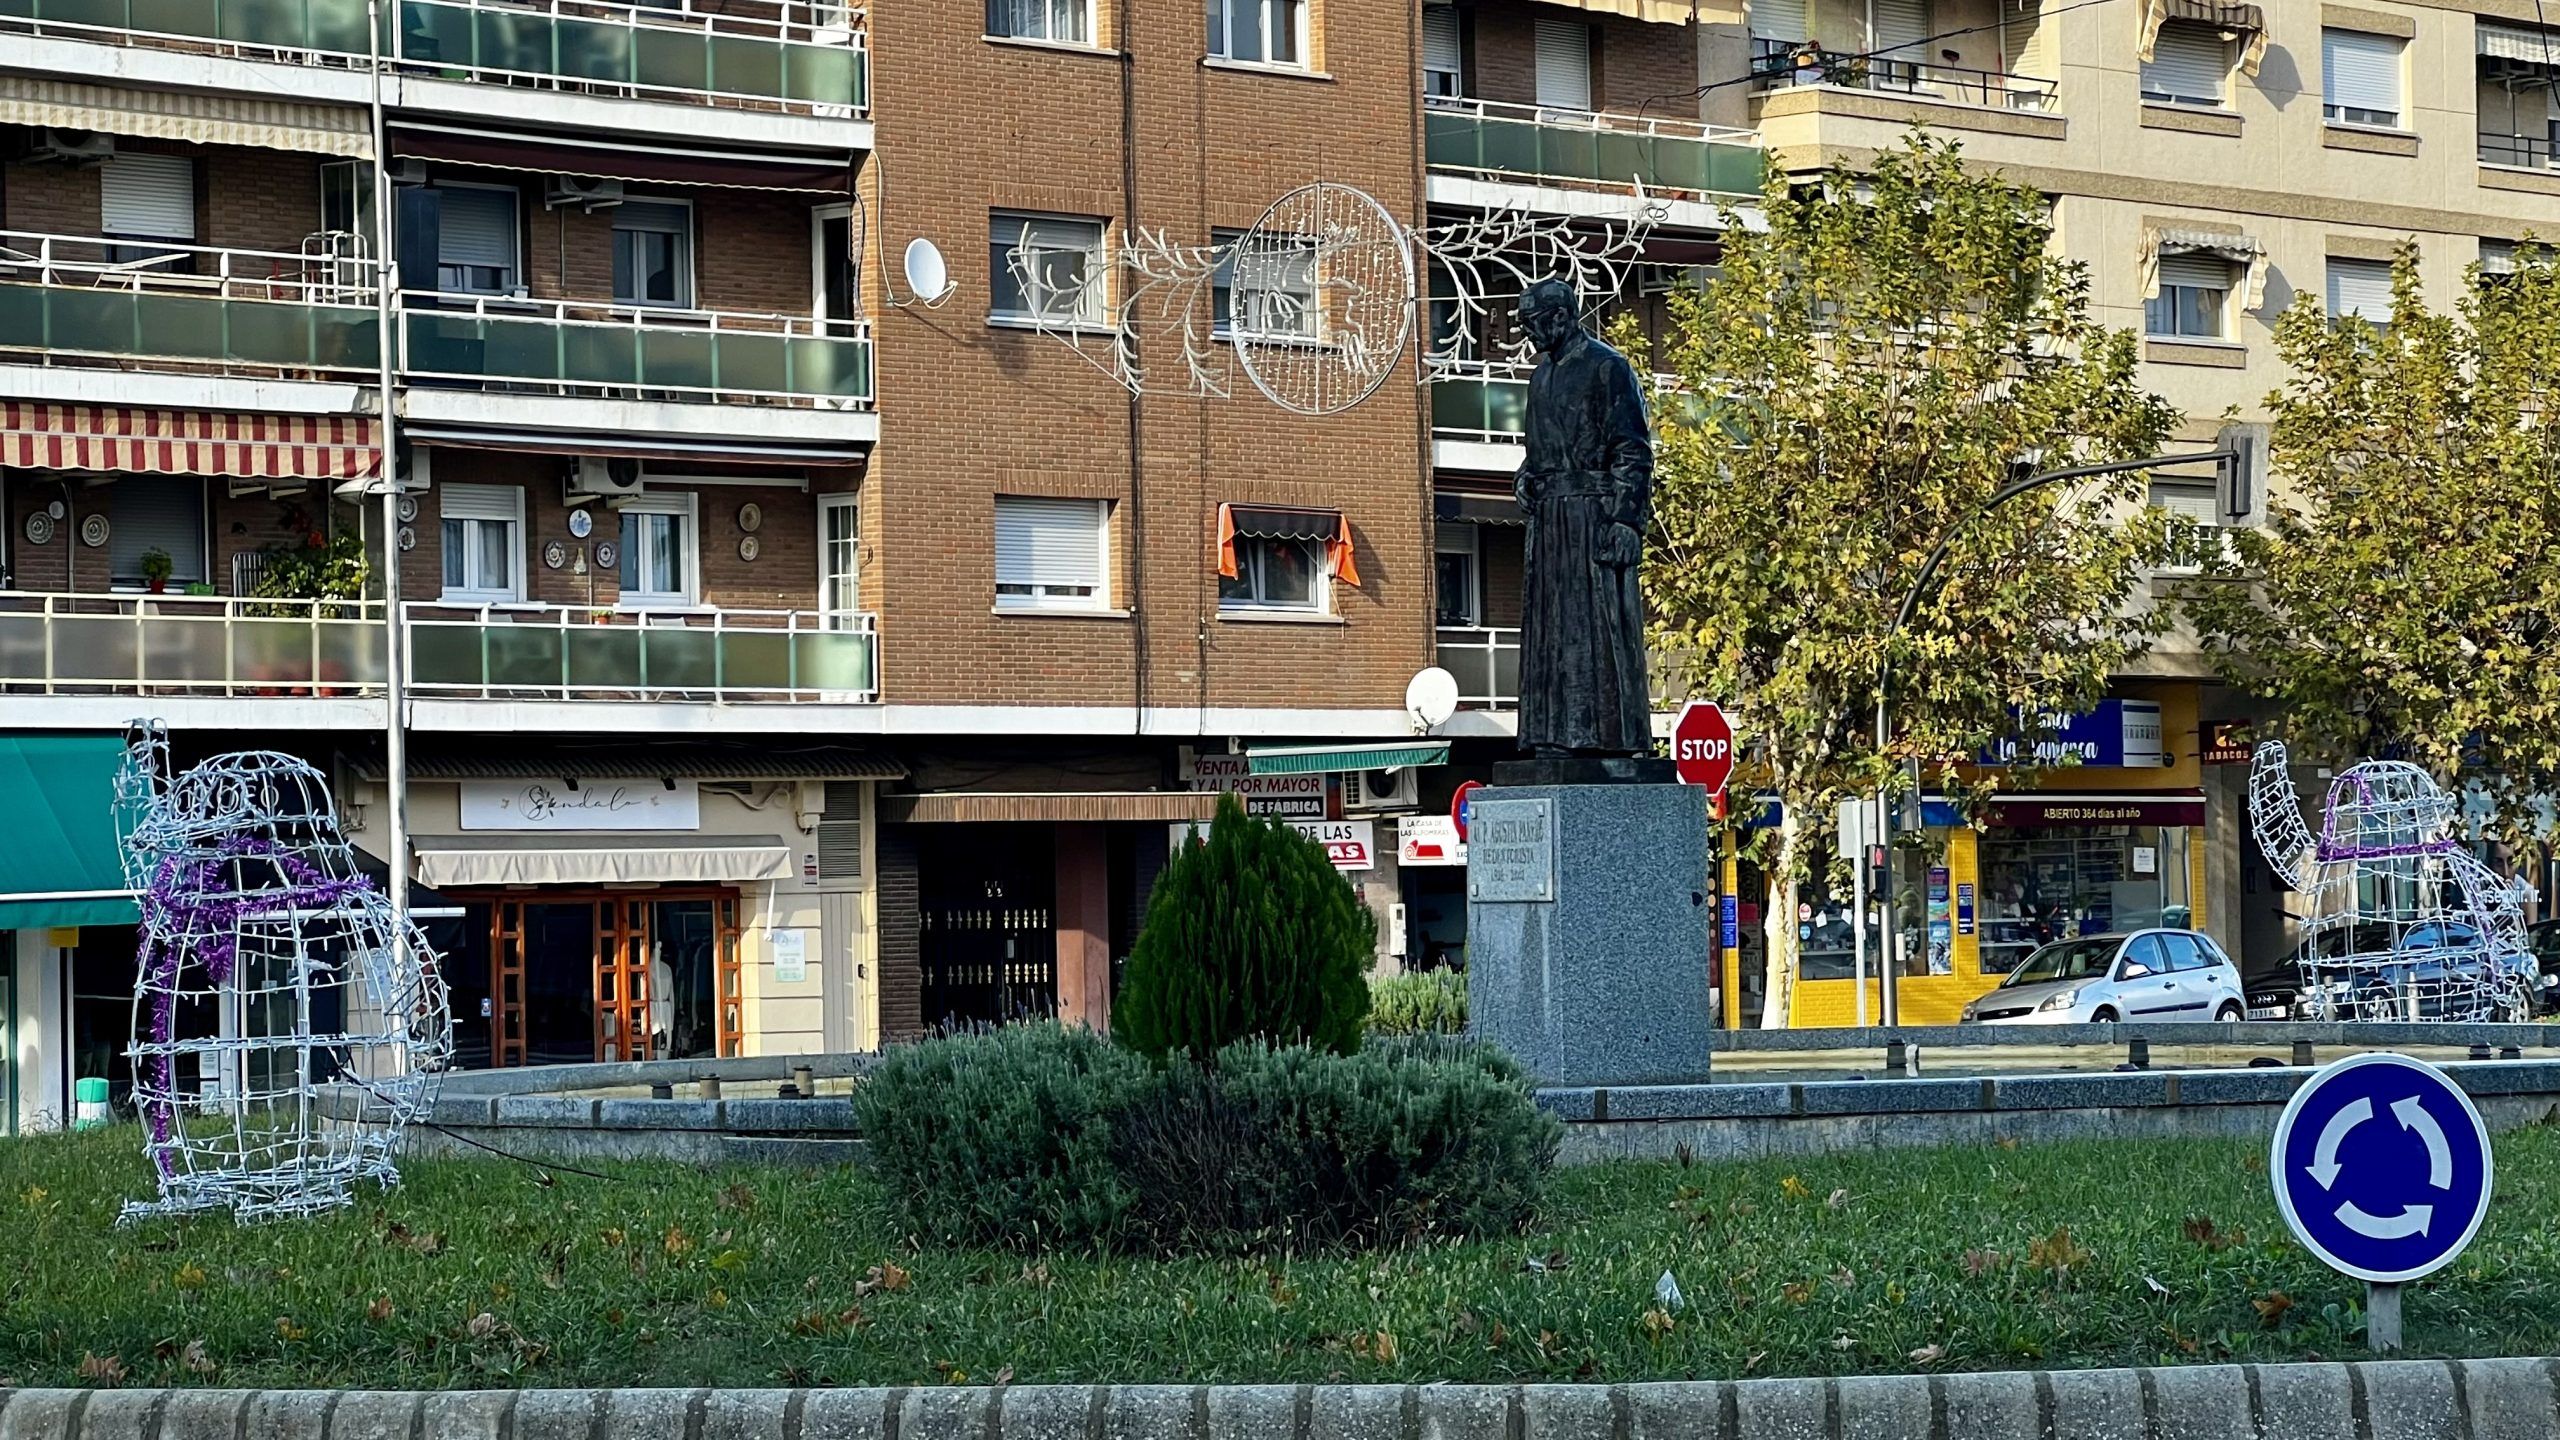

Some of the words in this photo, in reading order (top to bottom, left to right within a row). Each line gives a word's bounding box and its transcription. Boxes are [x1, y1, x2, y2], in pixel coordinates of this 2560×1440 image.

[1681, 739, 1728, 761] STOP
[1999, 737, 2017, 761] La
[2203, 750, 2249, 760] TABACOS
[1194, 761, 1238, 775] VENTA
[1232, 778, 1262, 793] POR
[1266, 778, 1320, 793] MAYOR
[1249, 800, 1264, 814] DE
[1266, 799, 1320, 814] FÁBRICA
[2043, 808, 2080, 819] ABIERTO
[2082, 808, 2096, 819] 364
[2098, 808, 2114, 819] días
[2116, 808, 2124, 818] al
[2126, 807, 2140, 818] año
[1323, 825, 1352, 840] LAS
[1400, 829, 1412, 837] LAS
